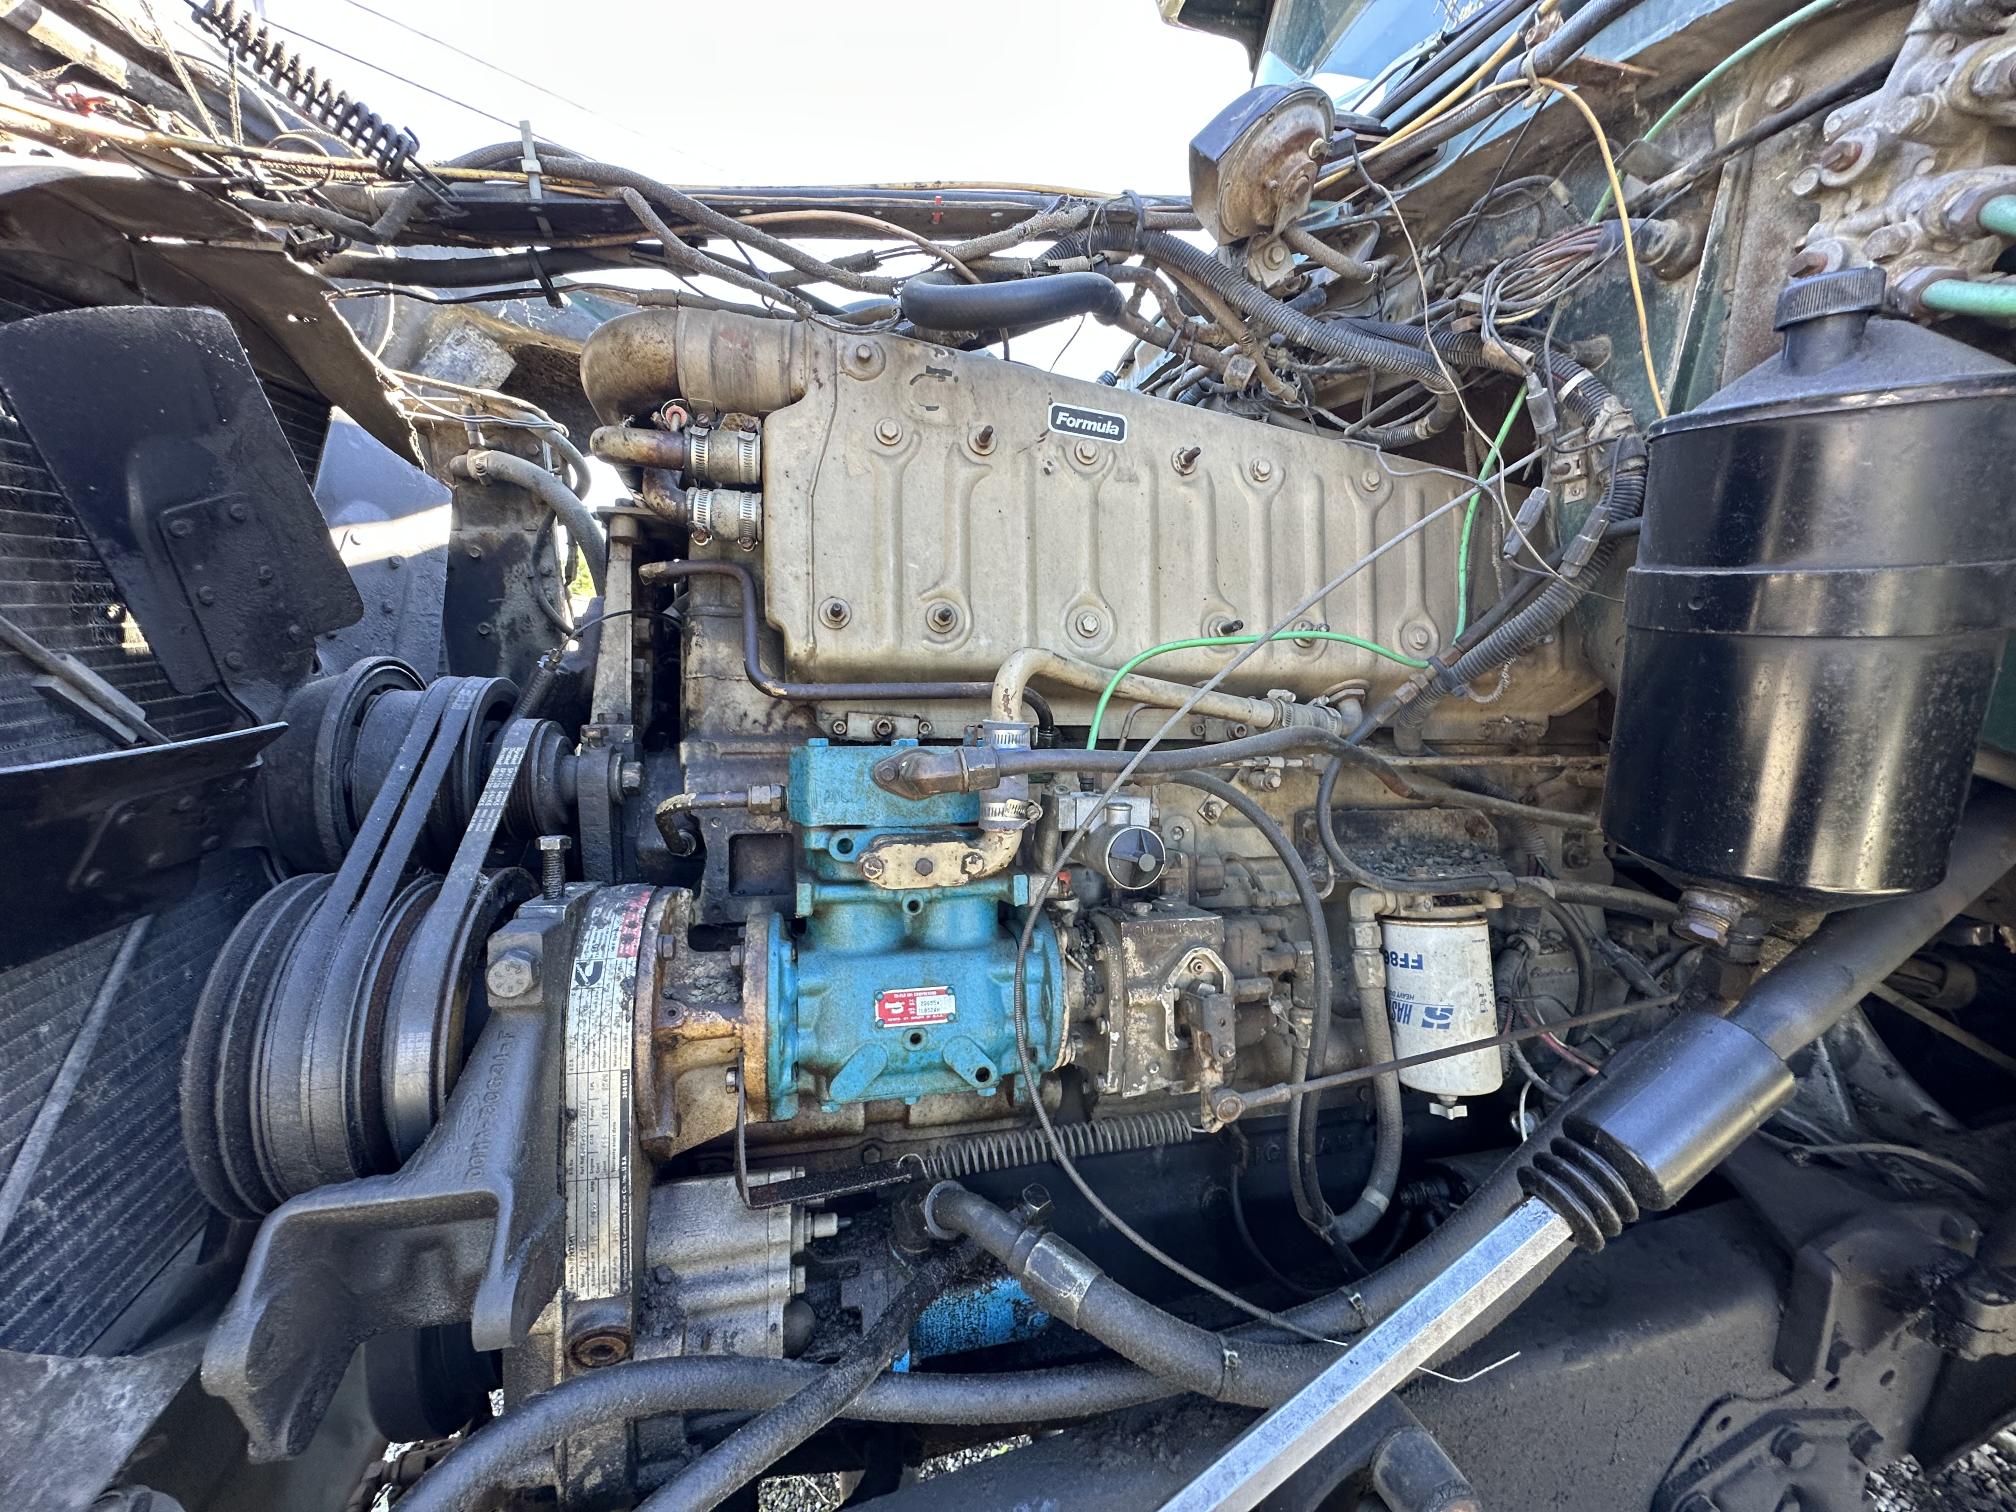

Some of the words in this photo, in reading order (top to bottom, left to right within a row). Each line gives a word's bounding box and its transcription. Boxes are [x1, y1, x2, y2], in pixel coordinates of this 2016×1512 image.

[1056, 411, 1120, 436] Formula
[1396, 991, 1414, 1001] HEAVY
[1388, 1000, 1412, 1025] HAS
